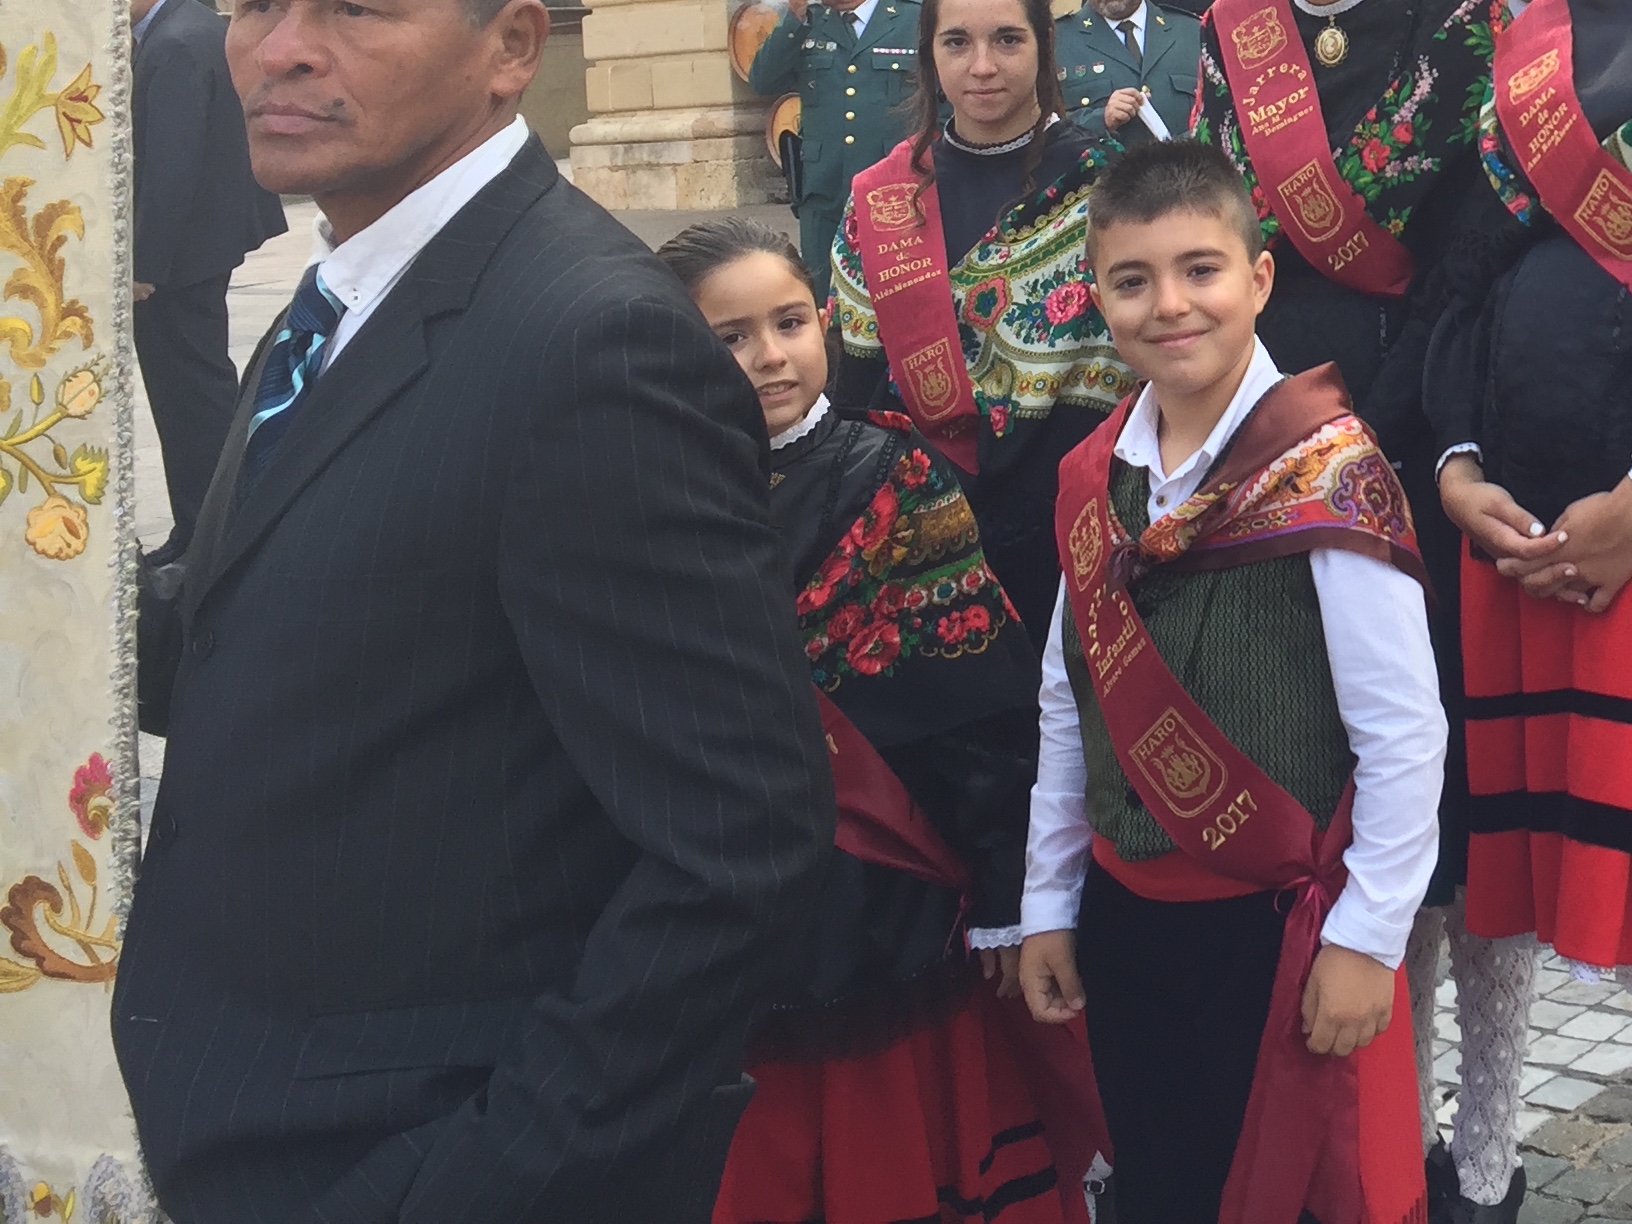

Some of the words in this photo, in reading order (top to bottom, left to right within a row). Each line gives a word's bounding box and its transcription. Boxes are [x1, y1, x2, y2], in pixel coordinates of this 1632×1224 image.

[1242, 62, 1307, 107] Jarrera
[1248, 86, 1309, 126] Mayor
[1519, 87, 1556, 127] DAMA
[1537, 109, 1549, 125] de
[1528, 102, 1568, 154] HONOR
[1282, 166, 1316, 197] HARO
[1580, 178, 1610, 220] HARO
[877, 236, 924, 255] DAMA
[896, 251, 910, 262] de
[1327, 230, 1370, 272] 2017
[878, 257, 933, 283] HONOR
[908, 344, 945, 369] HARO
[1138, 718, 1176, 761] HARO
[1203, 789, 1258, 851] 2017
